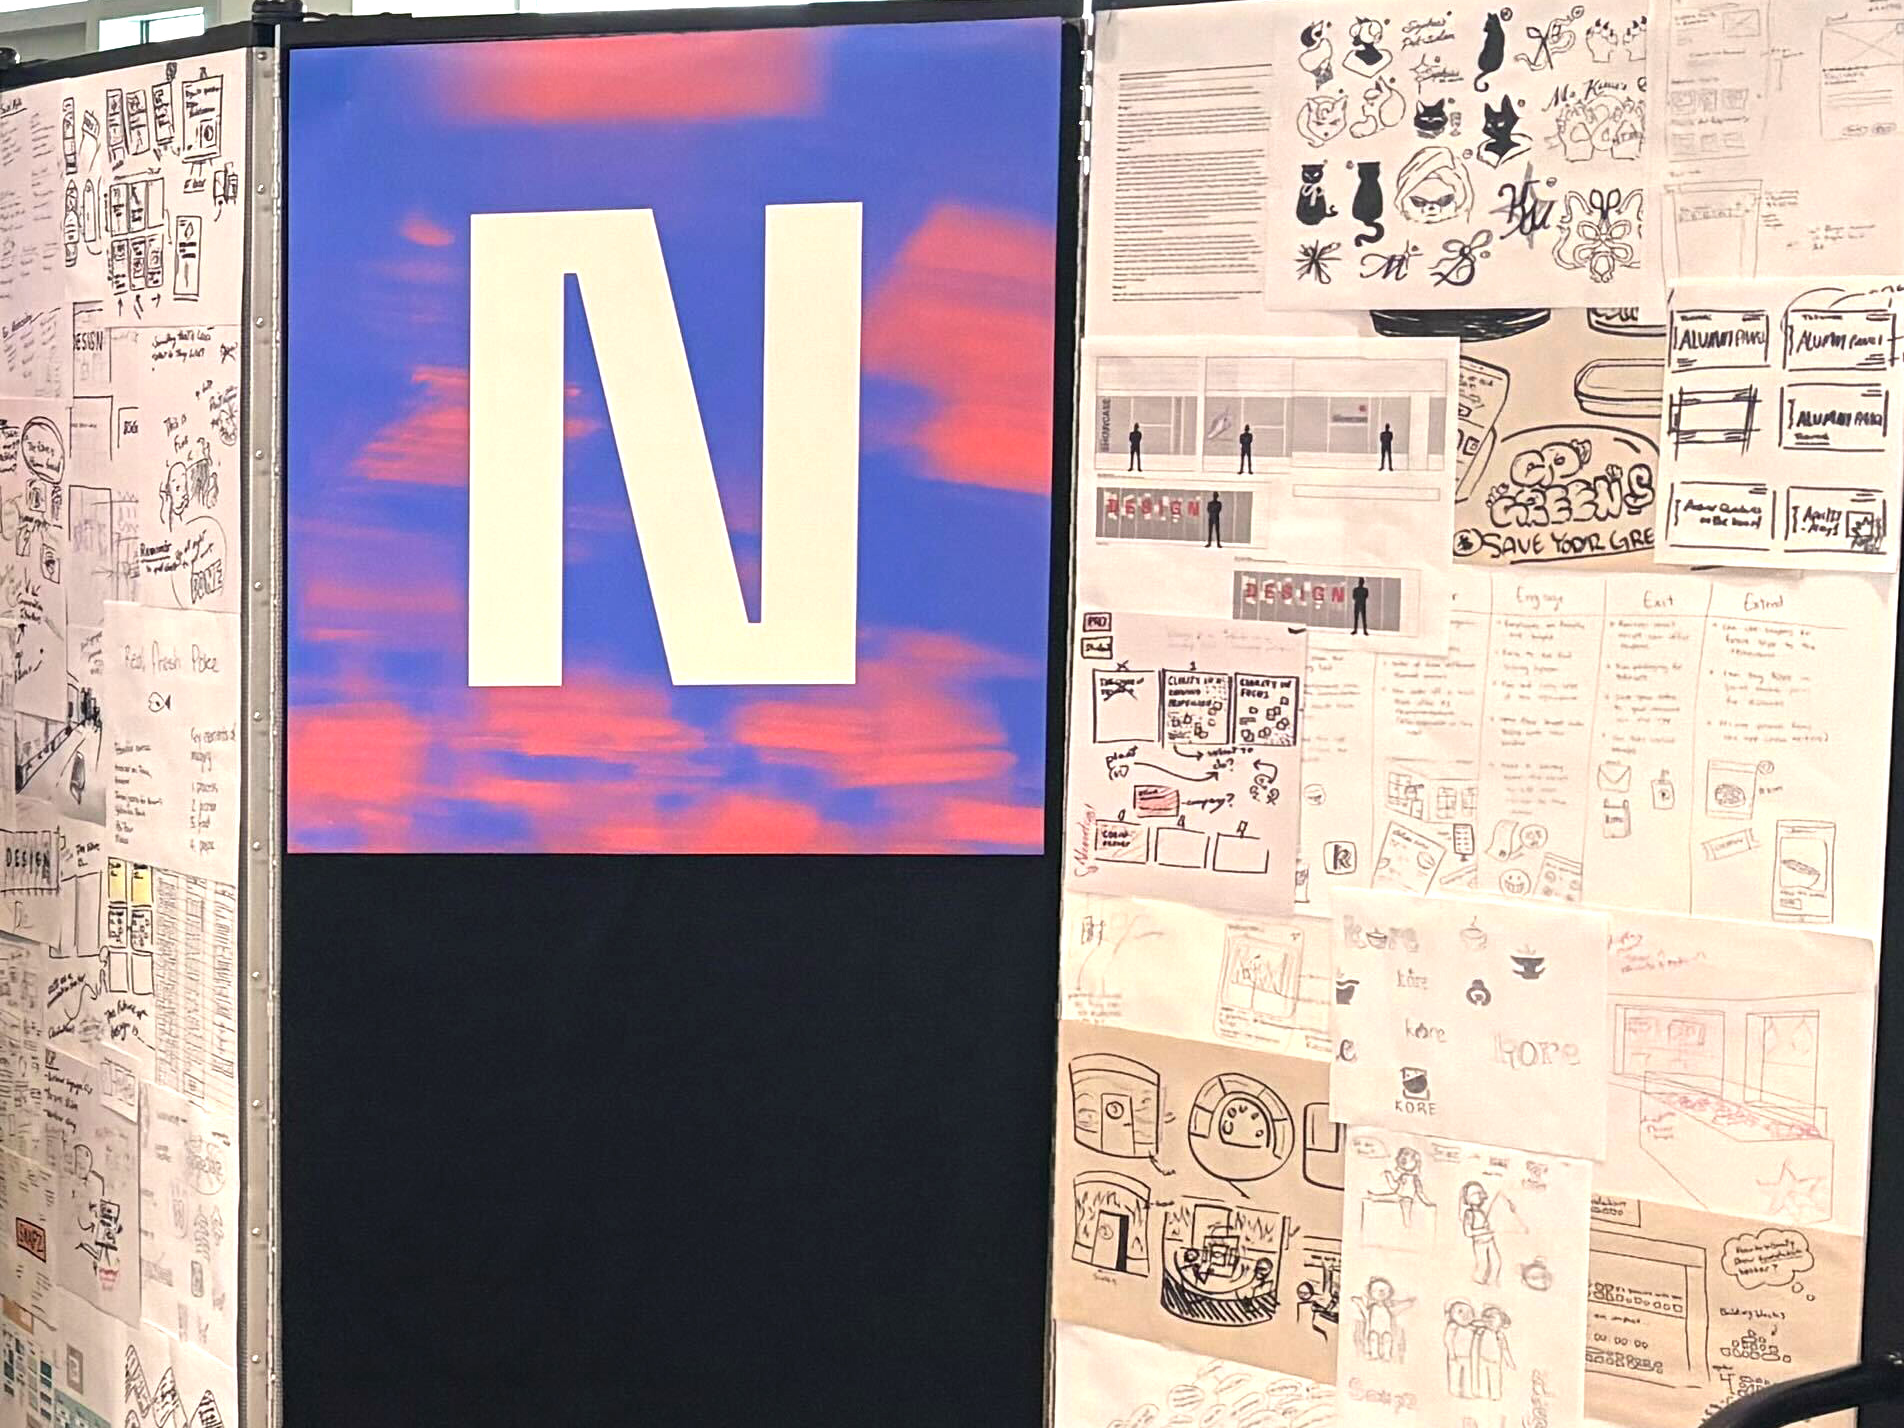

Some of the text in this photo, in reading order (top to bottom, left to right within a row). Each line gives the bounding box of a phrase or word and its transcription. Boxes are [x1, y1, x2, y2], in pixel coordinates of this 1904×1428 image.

[468, 200, 863, 687] N
[1106, 496, 1201, 518] DESIGN
[1482, 532, 1545, 558] SAVE
[1245, 580, 1346, 604] DESIGN
[1643, 590, 1673, 610] Exit
[5, 847, 52, 869] DESIGN
[1395, 1100, 1437, 1115] KORE
